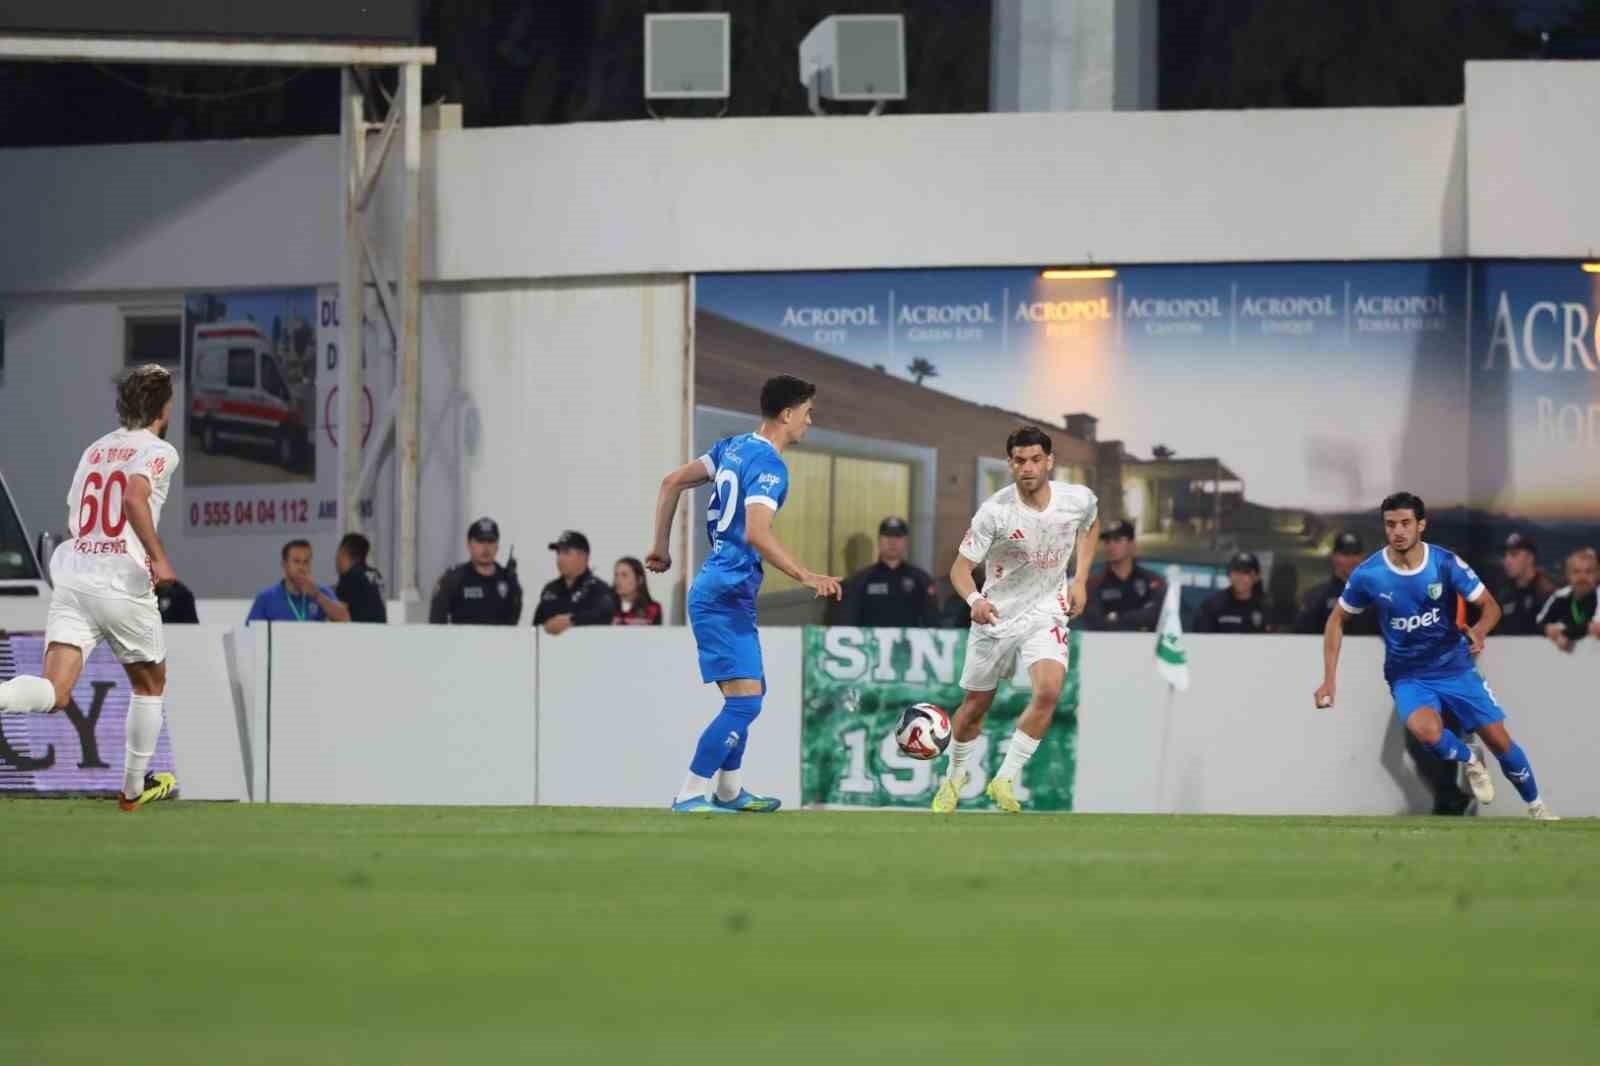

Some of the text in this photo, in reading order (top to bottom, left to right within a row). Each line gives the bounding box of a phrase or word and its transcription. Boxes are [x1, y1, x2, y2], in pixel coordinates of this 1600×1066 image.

[781, 304, 880, 327] ACROPOL
[899, 302, 993, 324] ACROPOL
[1015, 298, 1111, 322] ACROPOL
[1127, 297, 1223, 319] ACROPOL
[1241, 295, 1337, 318] ACROPOL
[1354, 294, 1446, 316] ACROPOL
[1483, 289, 1600, 372] ACR
[79, 470, 128, 538] 60
[190, 502, 199, 526] 0
[204, 502, 230, 526] 555
[235, 502, 253, 525] 04
[257, 500, 275, 524] 04
[281, 500, 308, 523] 112
[1391, 607, 1441, 633] opet
